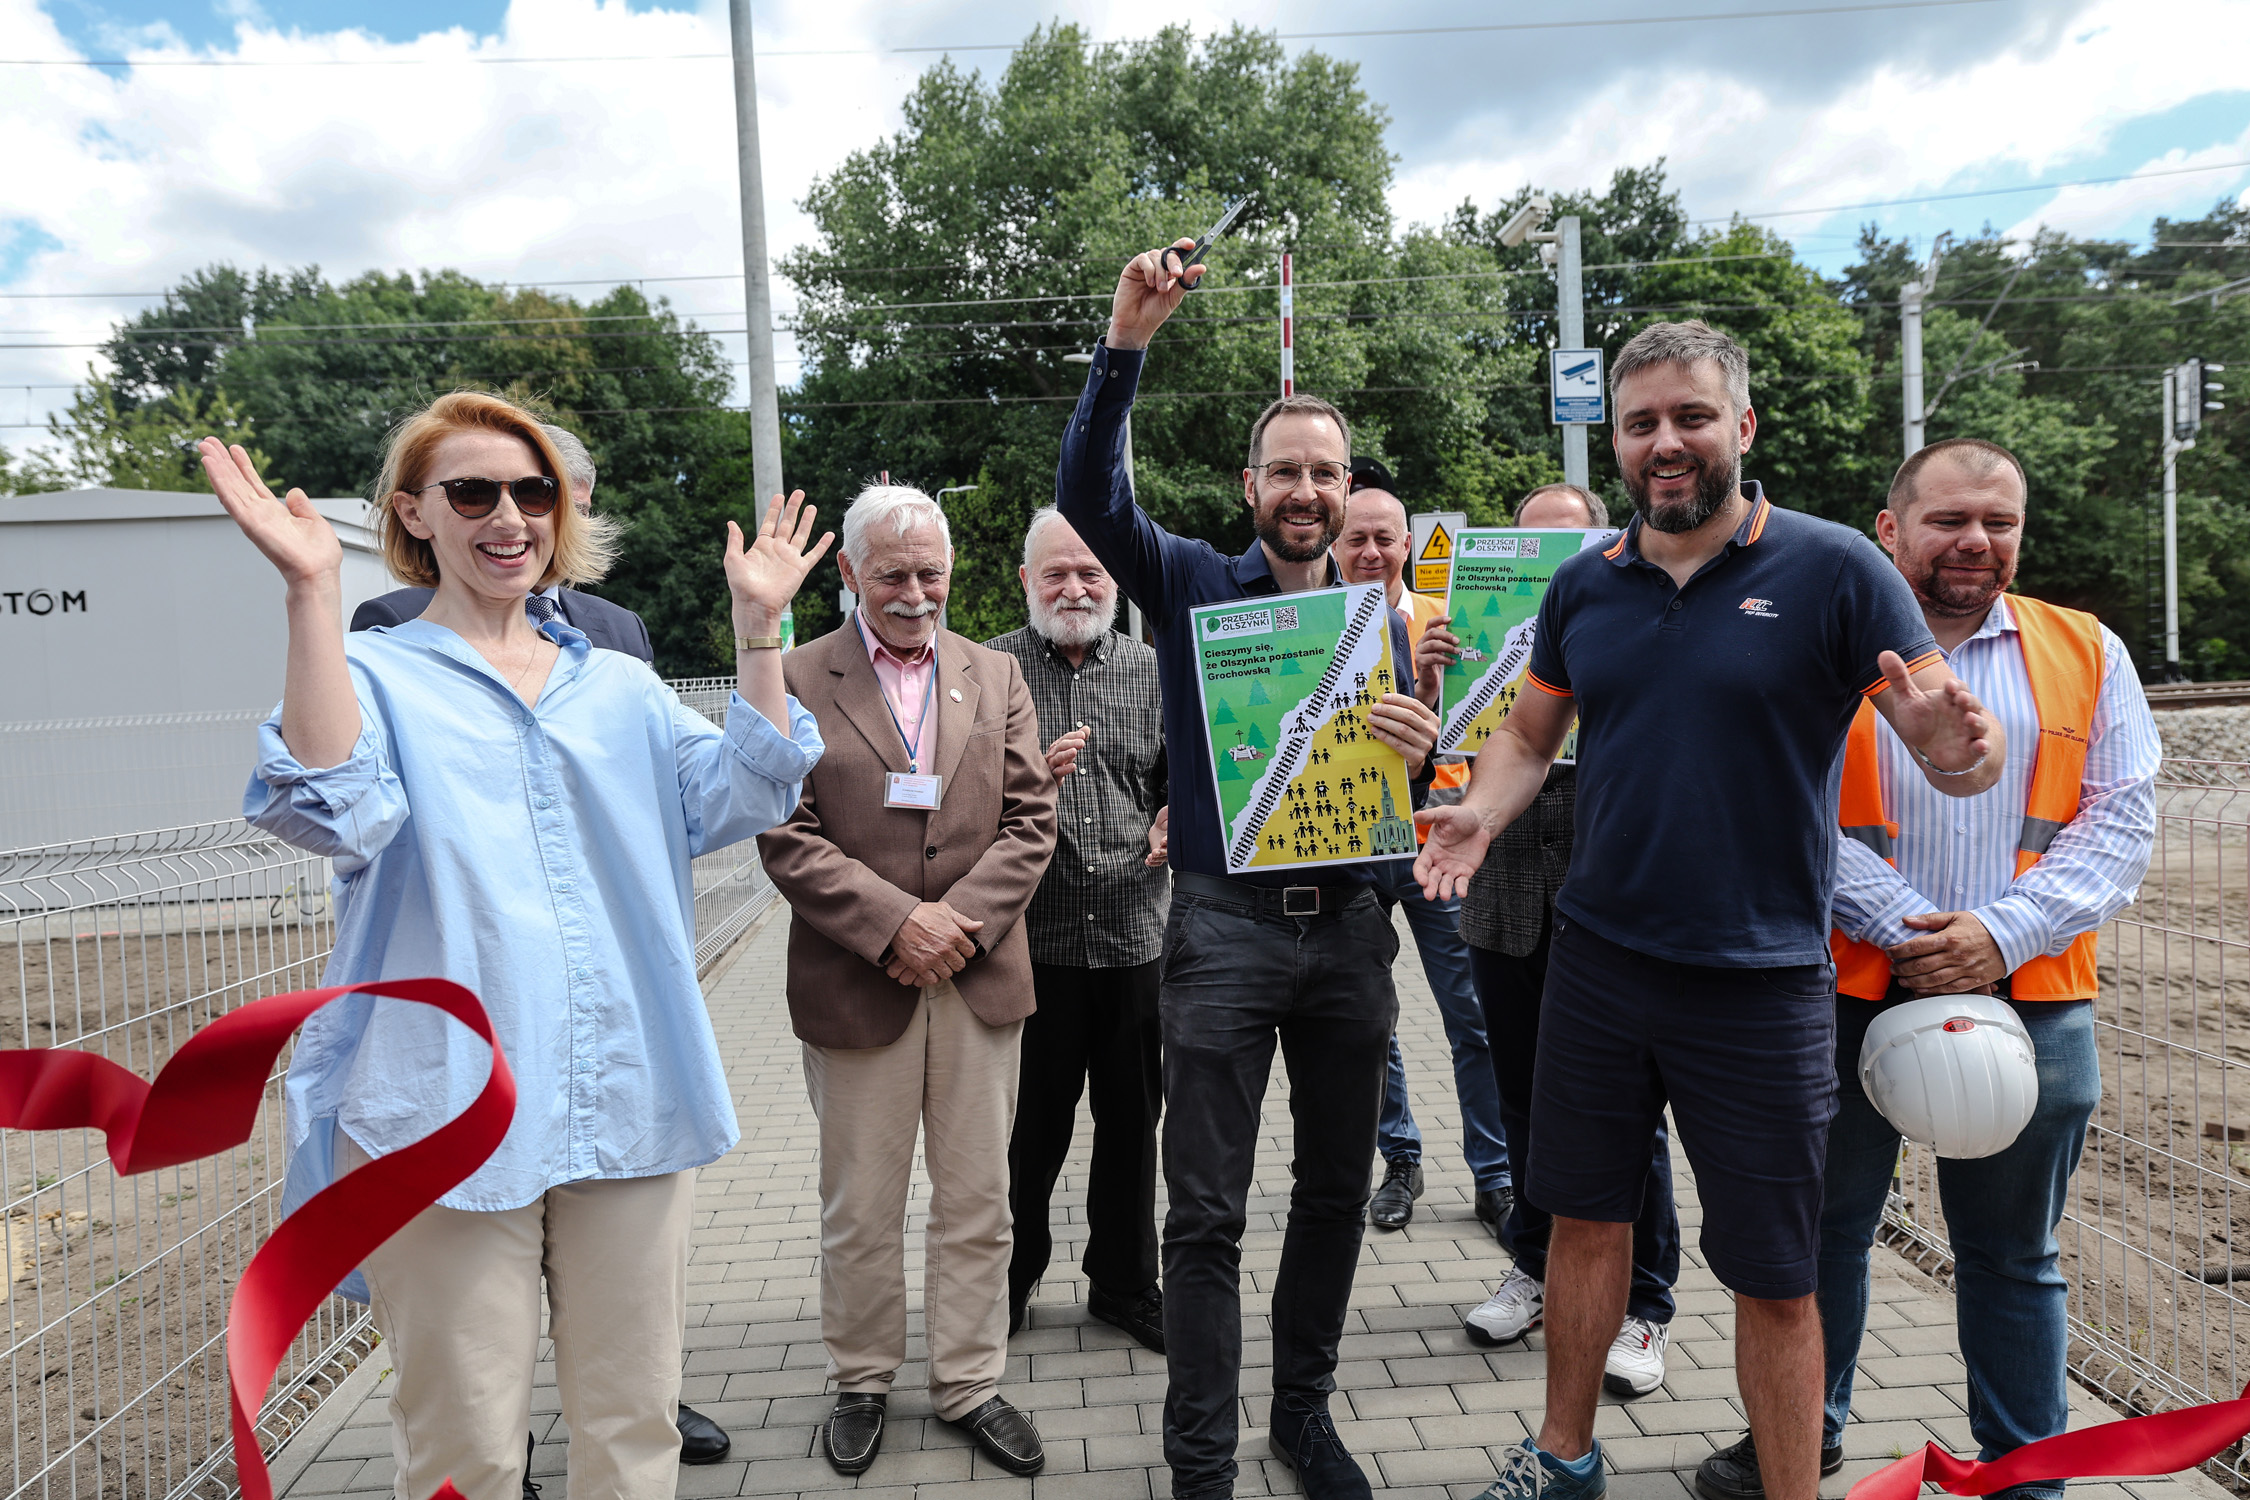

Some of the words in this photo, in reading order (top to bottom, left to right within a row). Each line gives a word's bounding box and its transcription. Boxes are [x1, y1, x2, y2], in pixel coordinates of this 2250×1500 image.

[1477, 538, 1516, 546] PRZEJŚCIE
[1457, 565, 1496, 573] Cieszymy
[1498, 565, 1514, 573] się,
[1467, 574, 1505, 582] Olszynka
[1455, 584, 1507, 592] Grochowską
[0, 588, 87, 616] TOM
[1221, 611, 1269, 624] PRZEJŚCIE
[1222, 618, 1270, 631] OLSZYNKI
[1204, 646, 1253, 659] Cieszymy
[1255, 643, 1274, 652] się,
[1206, 662, 1218, 670] że
[1220, 654, 1266, 668] Olszynka
[1269, 647, 1325, 663] pozostanie
[1207, 666, 1271, 681] Grochowską
